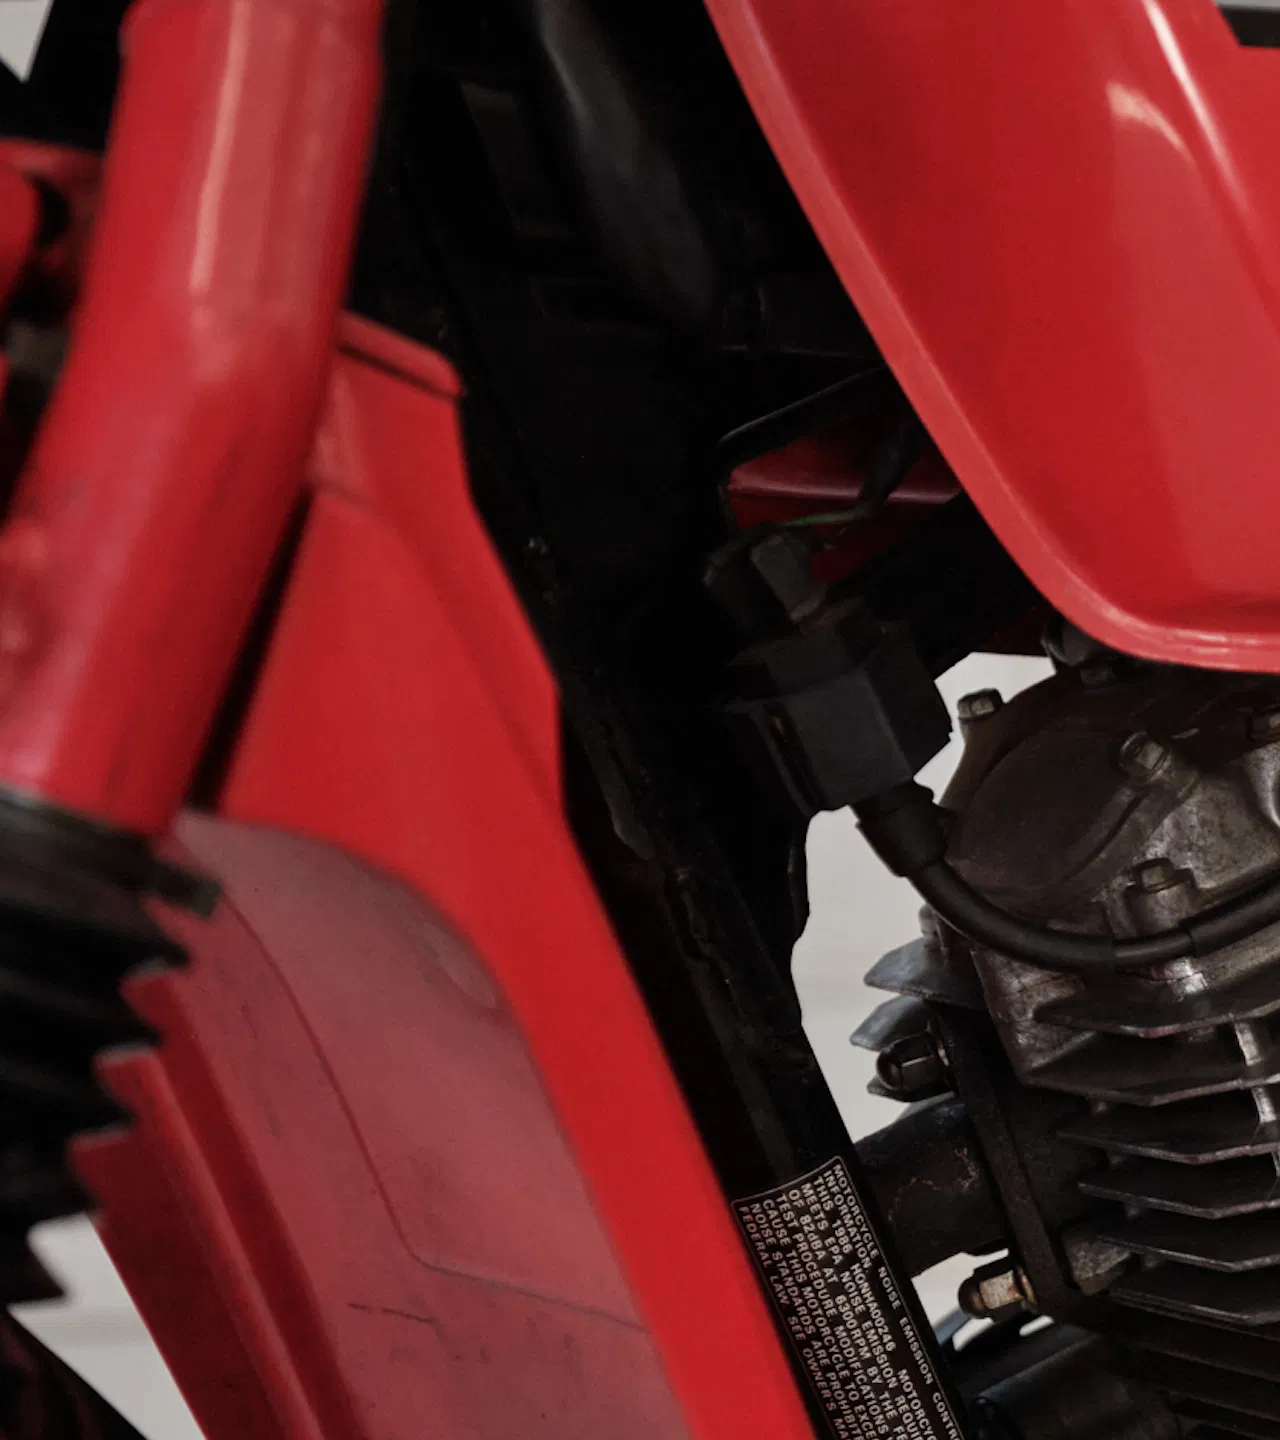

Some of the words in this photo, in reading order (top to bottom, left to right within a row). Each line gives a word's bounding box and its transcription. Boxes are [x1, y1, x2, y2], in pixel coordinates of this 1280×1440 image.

[738, 1204, 773, 1268] FEDERAL
[786, 1314, 806, 1343] SEE
[749, 1202, 777, 1247] NOISE
[770, 1250, 816, 1336] STANDARDS
[809, 1338, 830, 1367] ARE
[761, 1198, 791, 1247] CAUSE
[784, 1249, 807, 1283] THIS
[800, 1285, 850, 1380] MOTORCYCLE
[842, 1382, 860, 1402] TO
[774, 1193, 799, 1230] TEST
[832, 1324, 889, 1435] MODIFICATIONS
[787, 1187, 805, 1209] OF
[798, 1213, 827, 1260] 82dBA
[821, 1265, 838, 1285] AT
[865, 1365, 883, 1386] BY
[876, 1390, 897, 1420] THE
[799, 1182, 829, 1231] MEETS
[823, 1236, 844, 1265] EPA
[838, 1270, 866, 1315] NOISE
[860, 1320, 898, 1389] EMISSION
[810, 1176, 834, 1212] THIS
[829, 1218, 853, 1255] 1986
[849, 1262, 896, 1352] HONHA00246
[830, 1164, 879, 1259] MOTORCYCLE
[875, 1266, 901, 1309] NOISE
[898, 1316, 934, 1384] EMISSION
